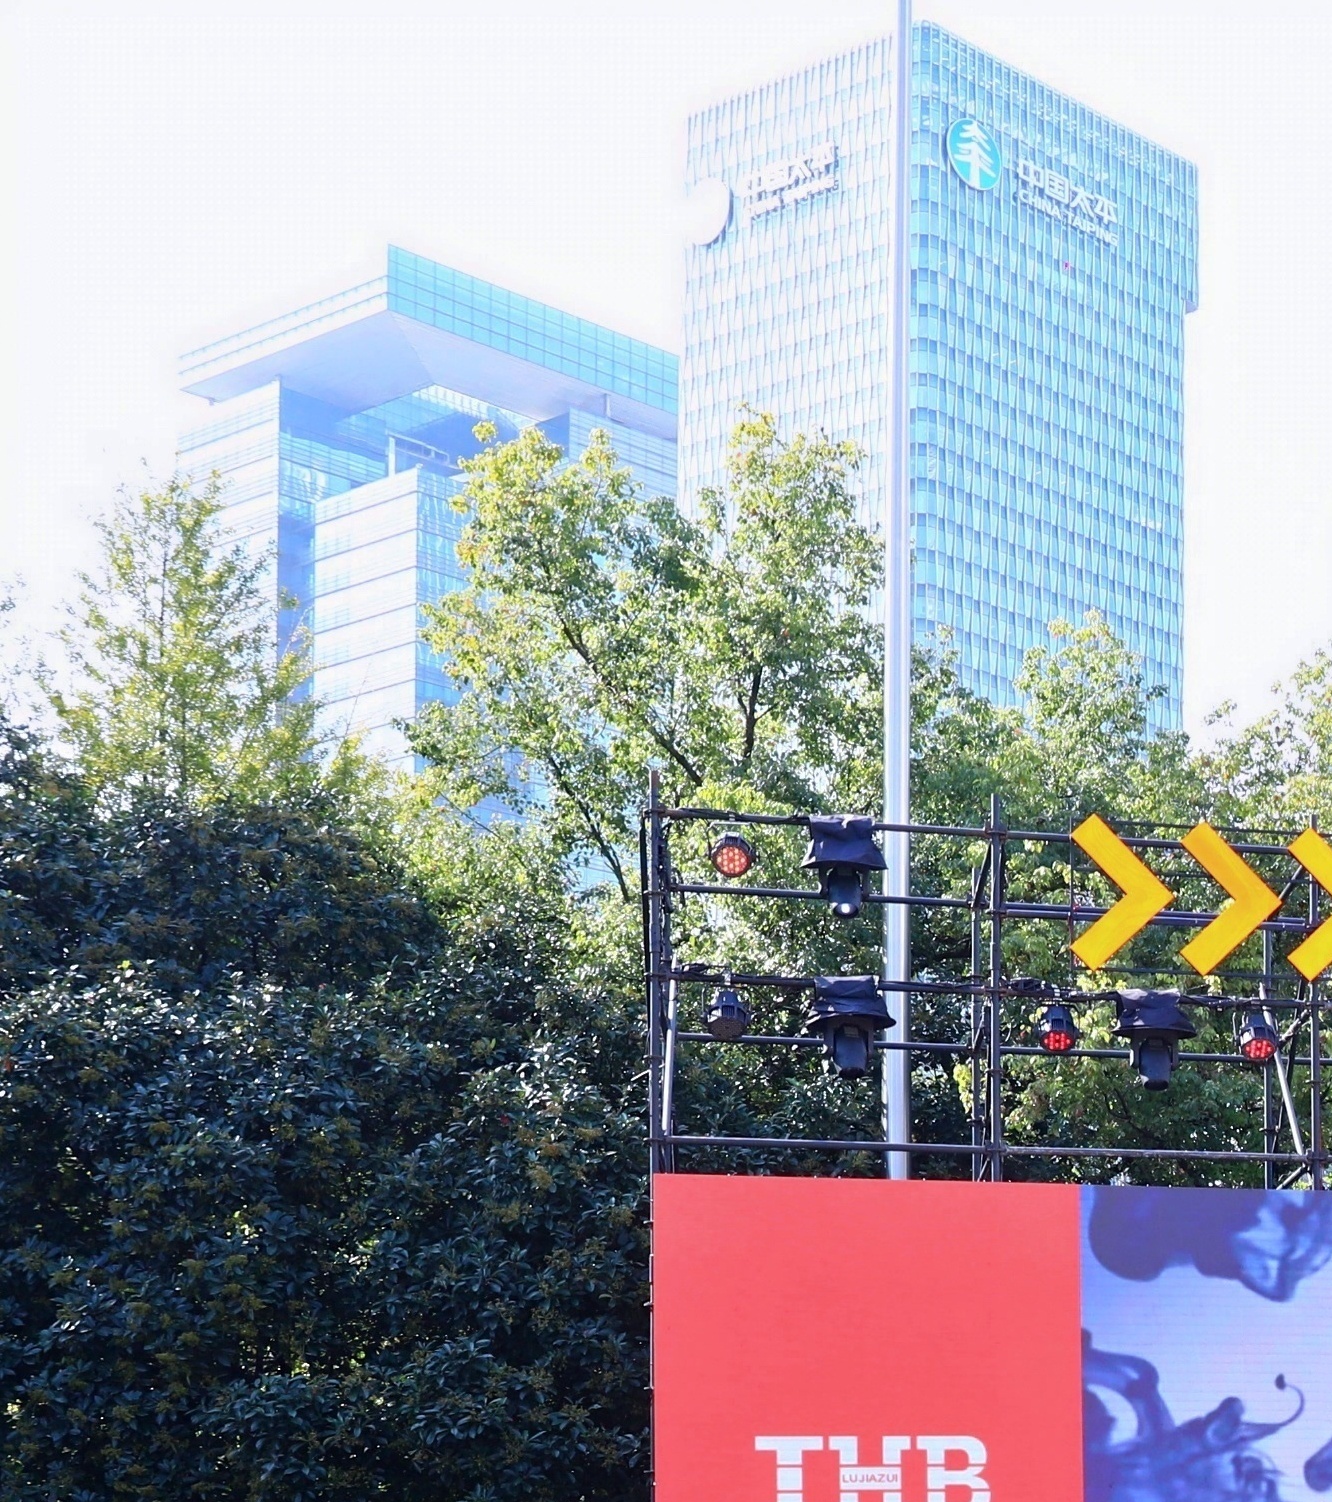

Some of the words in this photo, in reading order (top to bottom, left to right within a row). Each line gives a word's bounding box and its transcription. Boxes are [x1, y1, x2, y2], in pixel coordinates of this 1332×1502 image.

[1017, 158, 1118, 225] 中国太平
[1018, 189, 1062, 220] CHINA
[1063, 210, 1119, 247] TAIPING
[841, 1473, 899, 1484] LUJIAZUI
